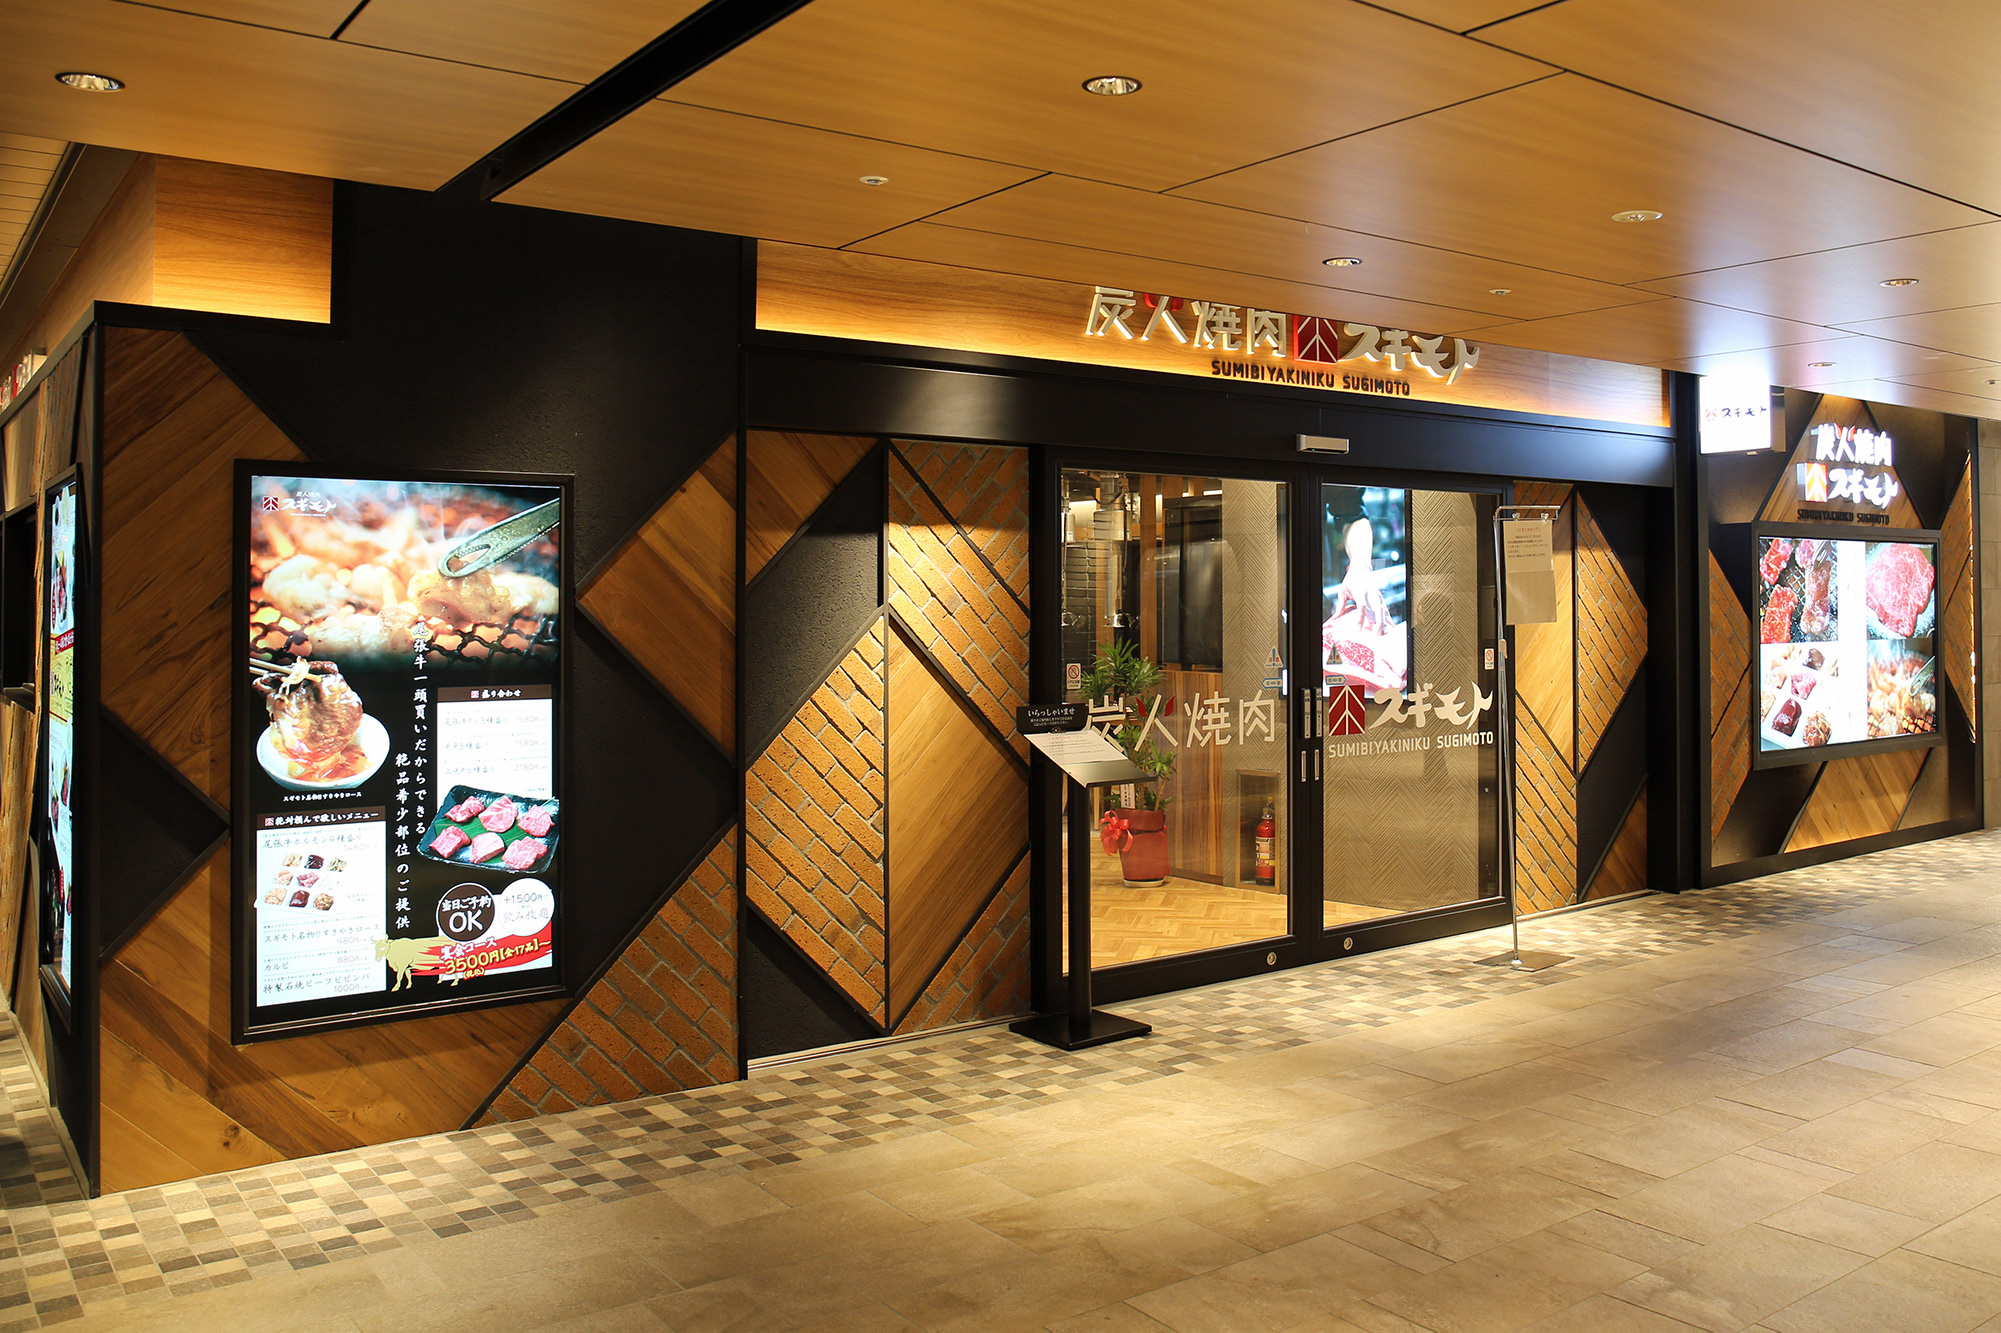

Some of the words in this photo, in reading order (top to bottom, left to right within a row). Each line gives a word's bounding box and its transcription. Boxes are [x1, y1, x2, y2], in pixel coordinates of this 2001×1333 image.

[1338, 323, 1480, 385] スギモト
[1210, 360, 1335, 388] SUMIBIYAKINIKU
[1342, 375, 1411, 396] SUGIMOTO
[1828, 468, 1898, 509] スギモト
[280, 498, 337, 514] スギモト
[482, 689, 521, 699] 盛り合わせ
[1369, 681, 1493, 730] スギモト
[1027, 707, 1076, 717] いらっしゃいませ
[1086, 689, 1275, 753] 炭火焼肉
[413, 620, 429, 835] 尾張牛一頭買いだからできる
[1328, 736, 1431, 758] SUMIBIYAKINIKU
[1436, 731, 1494, 749] SUGIMOTO
[274, 812, 379, 826] 絶対頼んで欲しいメニュー
[395, 752, 411, 930] 絶品希少部位のご提供
[441, 894, 492, 912] 当日ご予約
[503, 907, 550, 923] 飲み放題
[448, 909, 483, 933] OK
[440, 936, 498, 961] 宴会コース
[264, 961, 290, 972] カルビ
